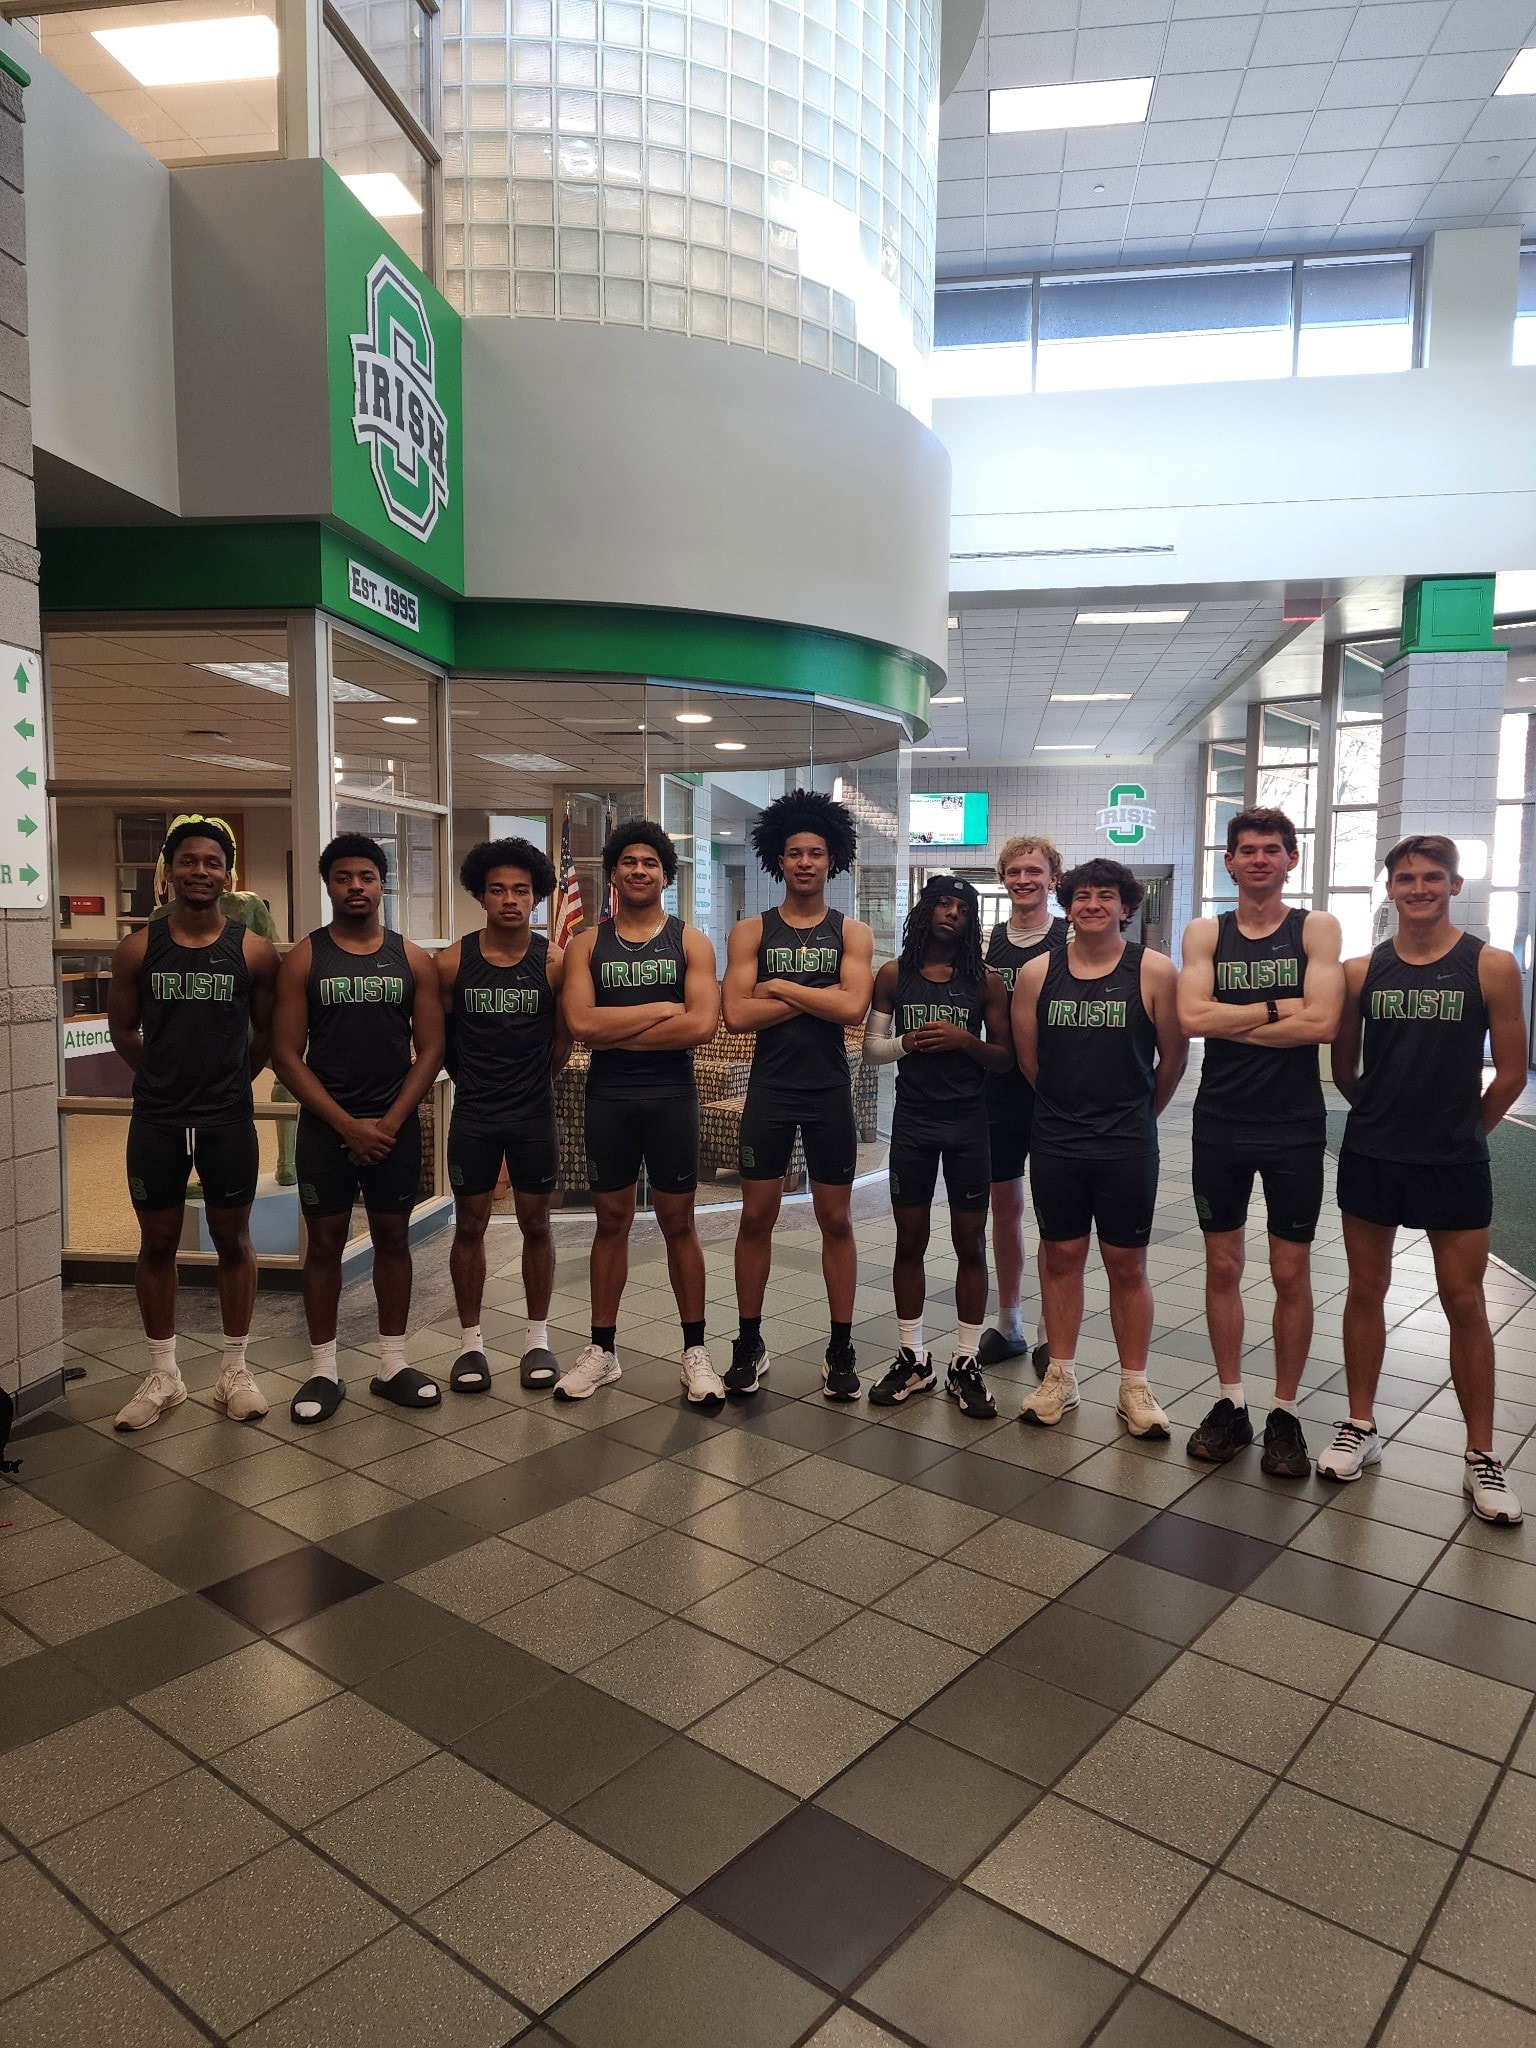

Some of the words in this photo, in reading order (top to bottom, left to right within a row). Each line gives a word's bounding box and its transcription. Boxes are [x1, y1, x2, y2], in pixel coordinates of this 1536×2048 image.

[358, 360, 446, 481] IRISH
[384, 585, 417, 624] 1995
[601, 959, 677, 988] IRISH
[766, 947, 838, 974] IRISH
[1217, 958, 1298, 990] IRISH
[151, 972, 235, 1001] IRISH
[320, 976, 403, 1005] IRISH
[464, 988, 539, 1013] IRISH
[903, 1004, 969, 1030] IRISH
[1047, 1000, 1127, 1028] IRISH
[1371, 989, 1465, 1022] IRISH
[740, 1145, 755, 1168] S
